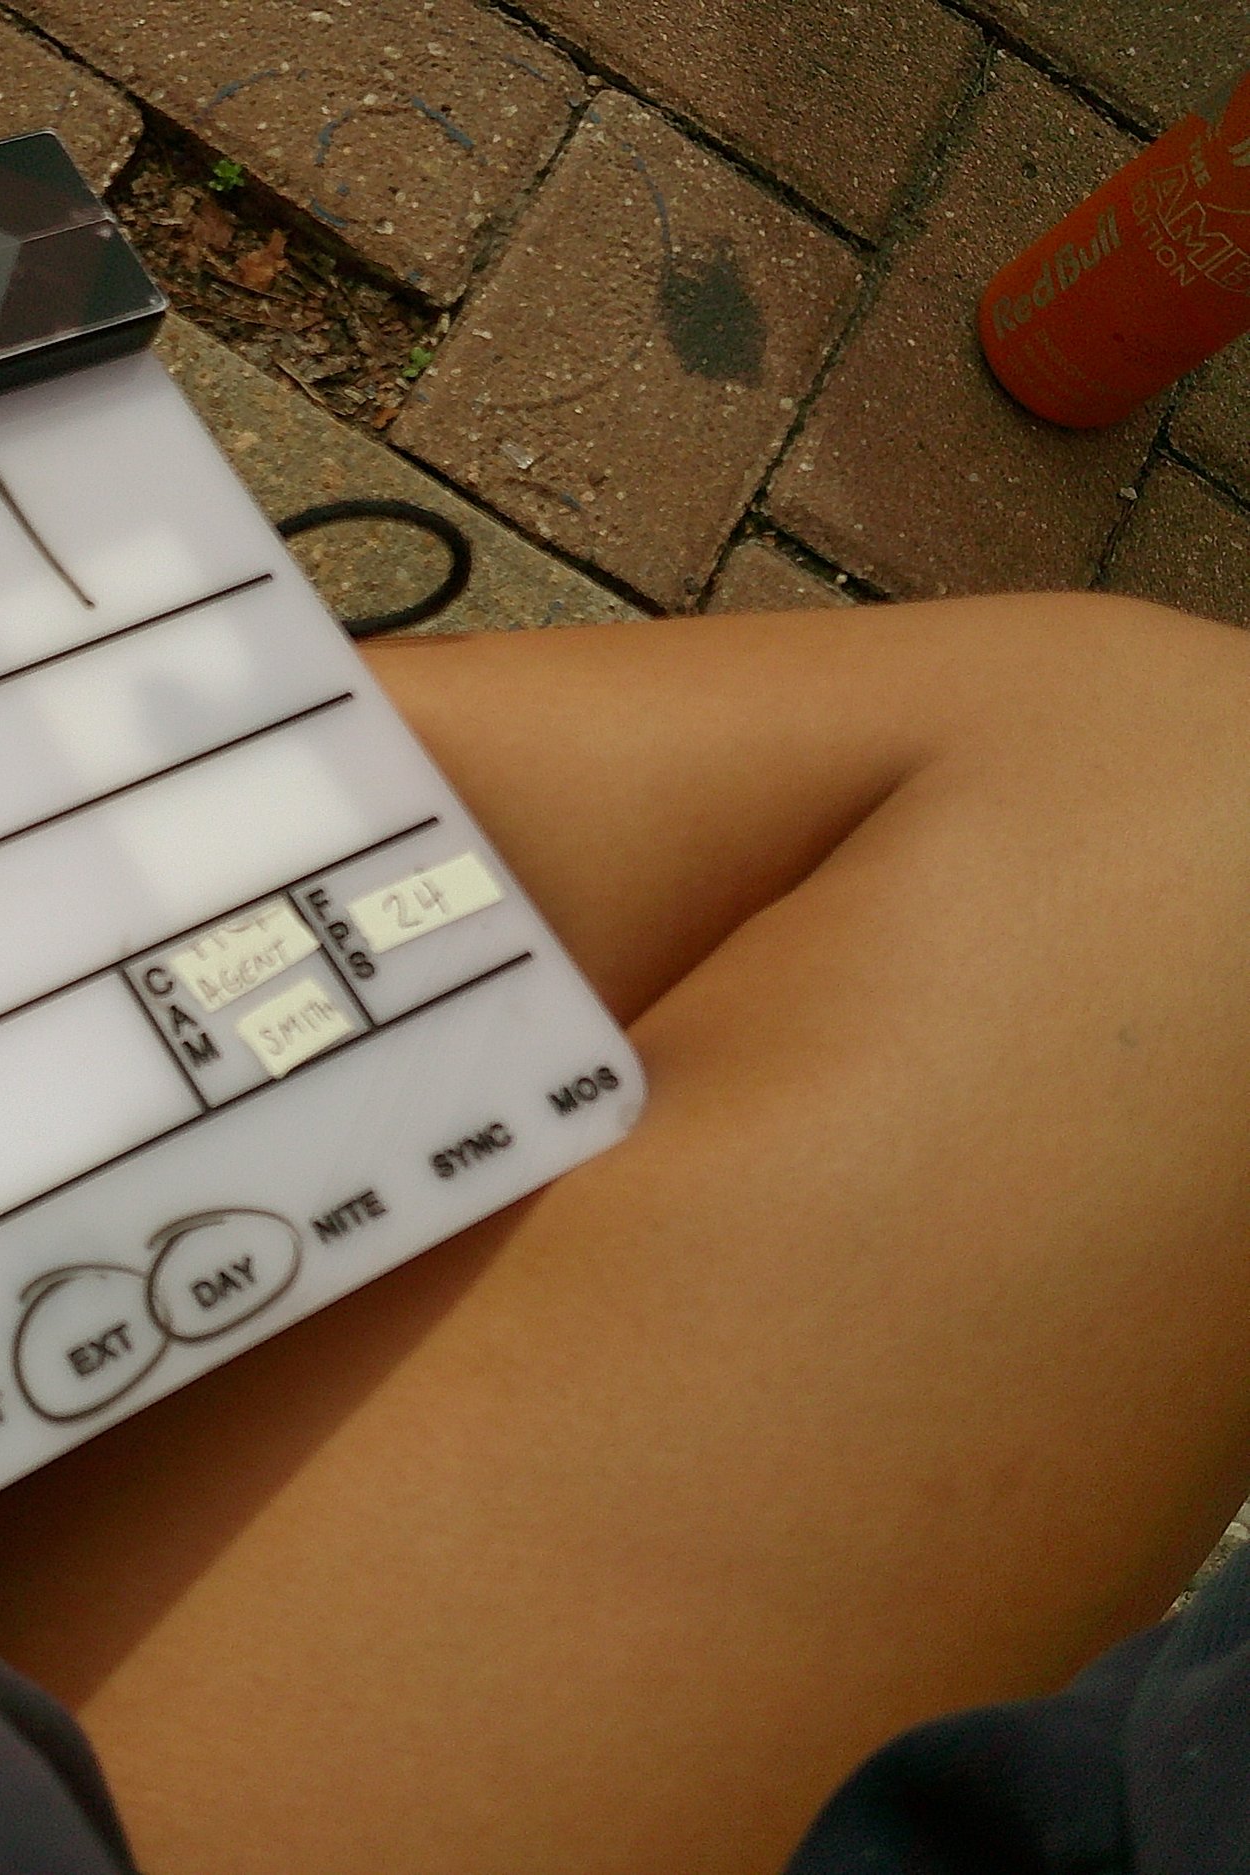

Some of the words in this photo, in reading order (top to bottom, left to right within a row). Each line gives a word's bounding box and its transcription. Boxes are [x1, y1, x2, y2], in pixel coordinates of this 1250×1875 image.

[307, 888, 376, 981] FPS
[381, 878, 448, 930] 24
[142, 965, 221, 1069] CAM
[66, 1322, 134, 1378] EXT
[190, 1256, 258, 1310] DAY
[311, 1188, 388, 1245] NITE
[429, 1120, 515, 1179] SYNC
[546, 1064, 620, 1117] MOS
